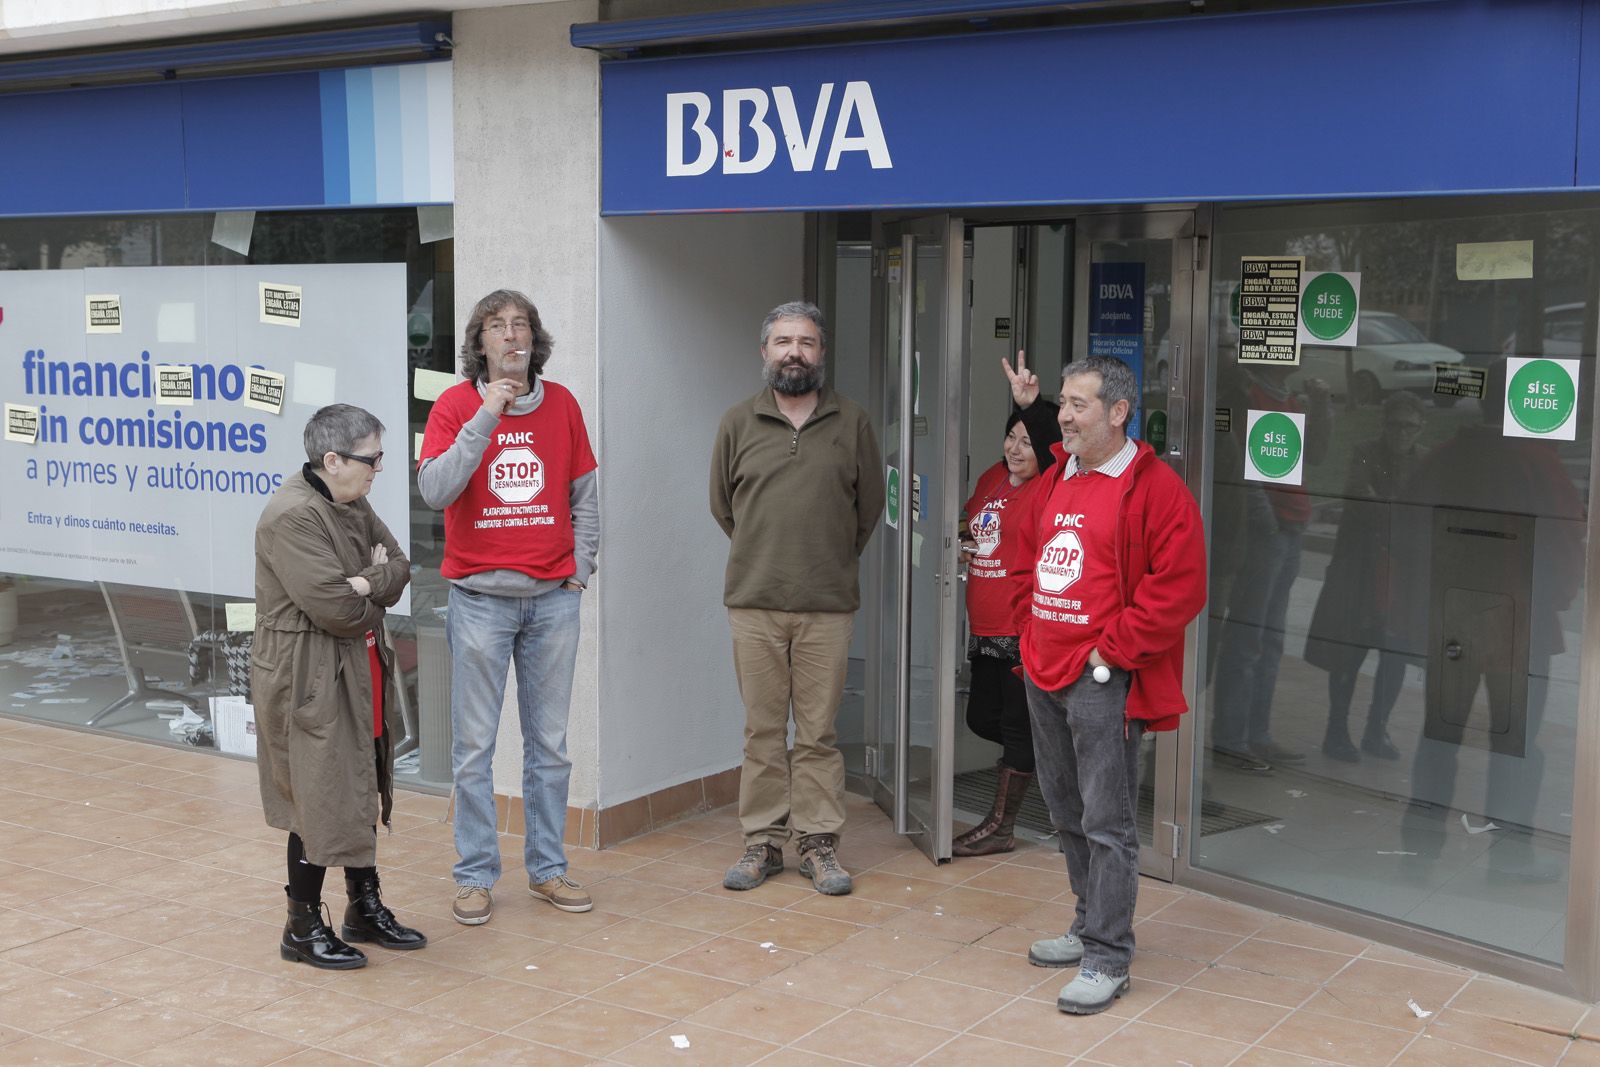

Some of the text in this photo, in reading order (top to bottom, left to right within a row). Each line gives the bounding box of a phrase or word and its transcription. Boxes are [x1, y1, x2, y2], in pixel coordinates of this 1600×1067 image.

[667, 81, 893, 177] BBVA
[1244, 263, 1268, 273] BBVA
[1100, 284, 1134, 299] BBVA
[1317, 292, 1340, 304] SÍ SE
[1243, 297, 1266, 306] BBVA
[1314, 308, 1343, 318] PUEDE
[1242, 330, 1265, 340] BBVA
[1527, 380, 1556, 394] SÍ SE
[1523, 398, 1558, 410] PUEDE
[36, 405, 267, 454] in comisiones
[497, 432, 534, 445] PAHC
[1264, 431, 1286, 444] SÍ SE
[1261, 445, 1288, 458] PUEDE
[26, 458, 38, 480] a
[46, 458, 117, 487] pymes
[125, 464, 138, 492] y
[494, 462, 539, 480] STOP
[494, 480, 540, 489] DESNONAMENTS
[28, 511, 179, 536] Entra y dinos cuánto necesitas.
[524, 517, 529, 526] EL
[1043, 547, 1079, 567] STOP
[1071, 600, 1082, 610] PER
[1052, 611, 1058, 621] EL
[1058, 612, 1089, 624] CAPITALISME
